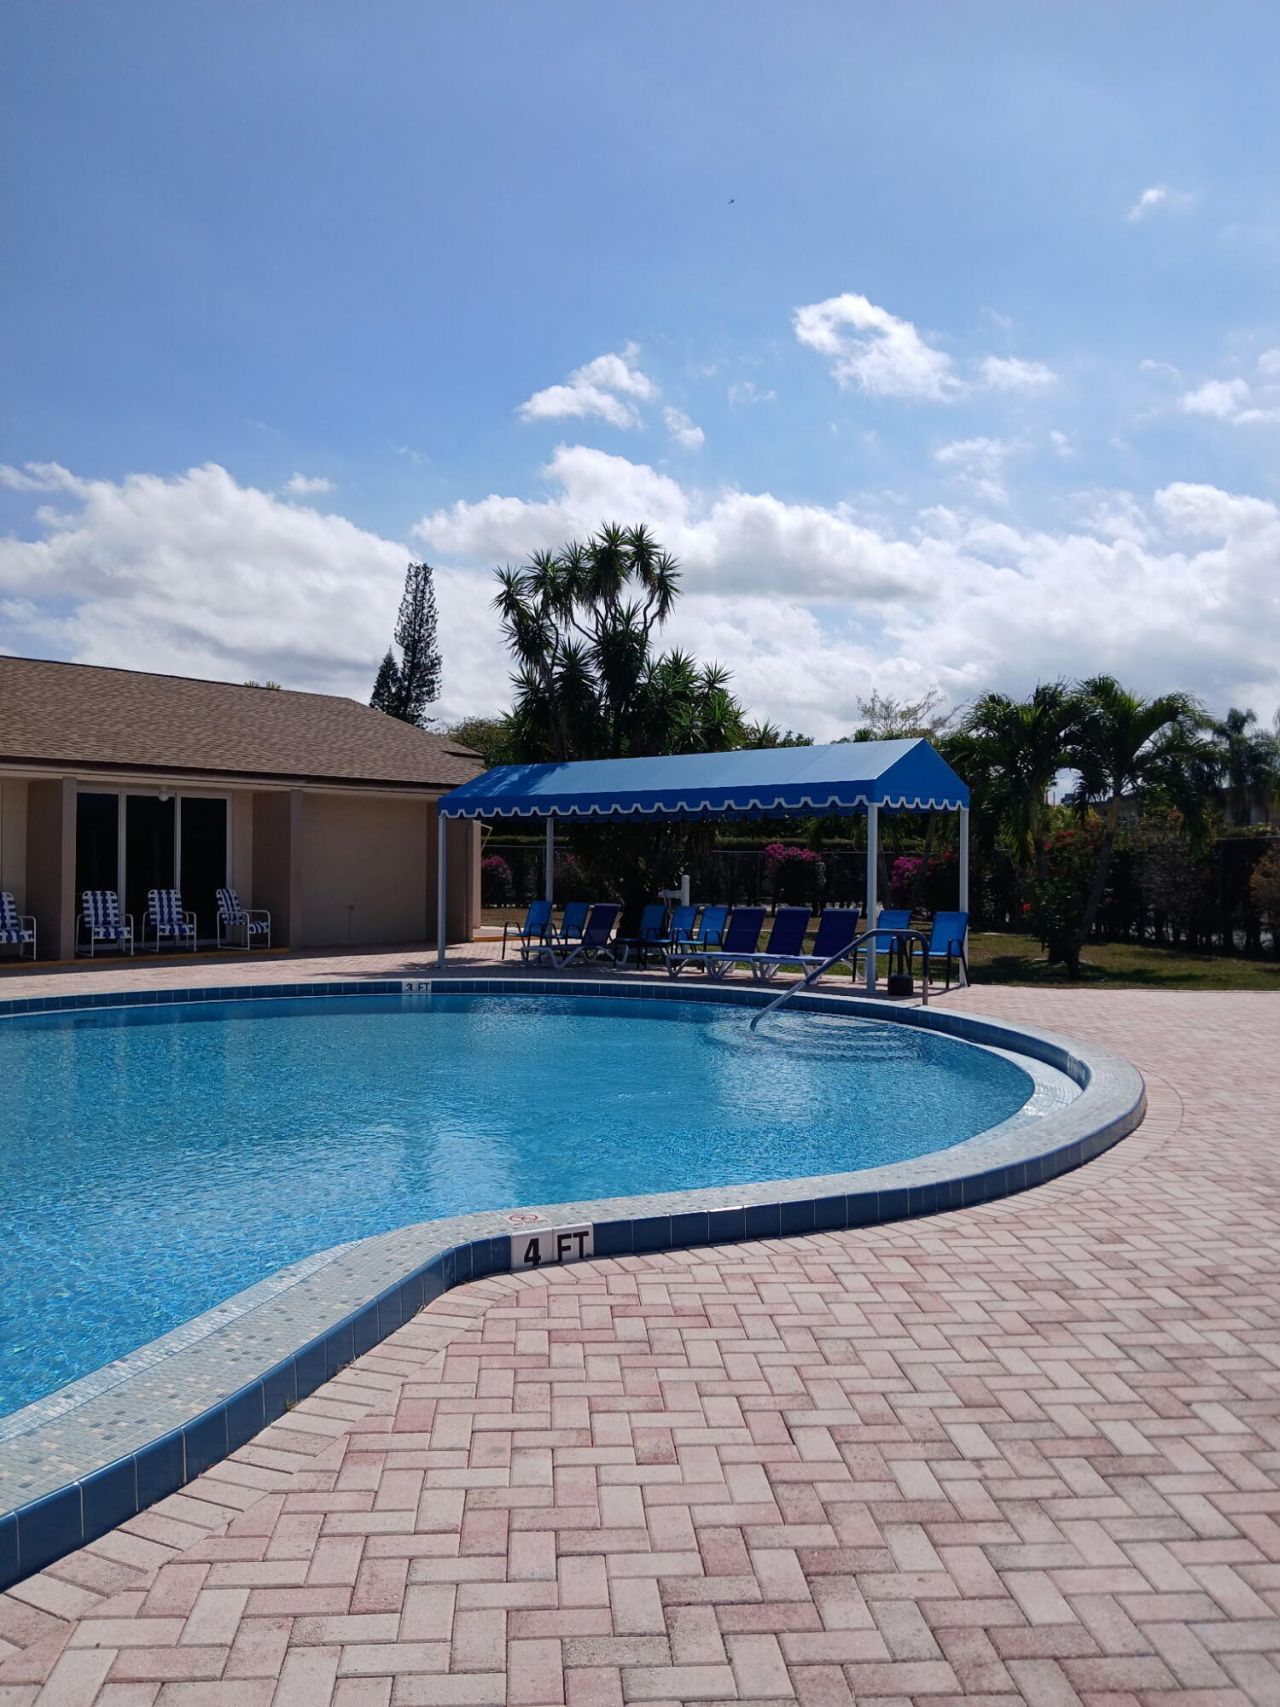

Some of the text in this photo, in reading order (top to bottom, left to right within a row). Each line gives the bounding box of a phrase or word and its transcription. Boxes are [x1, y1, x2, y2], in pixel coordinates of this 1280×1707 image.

[418, 982, 430, 991] FT
[524, 1231, 589, 1266] 4 FT
